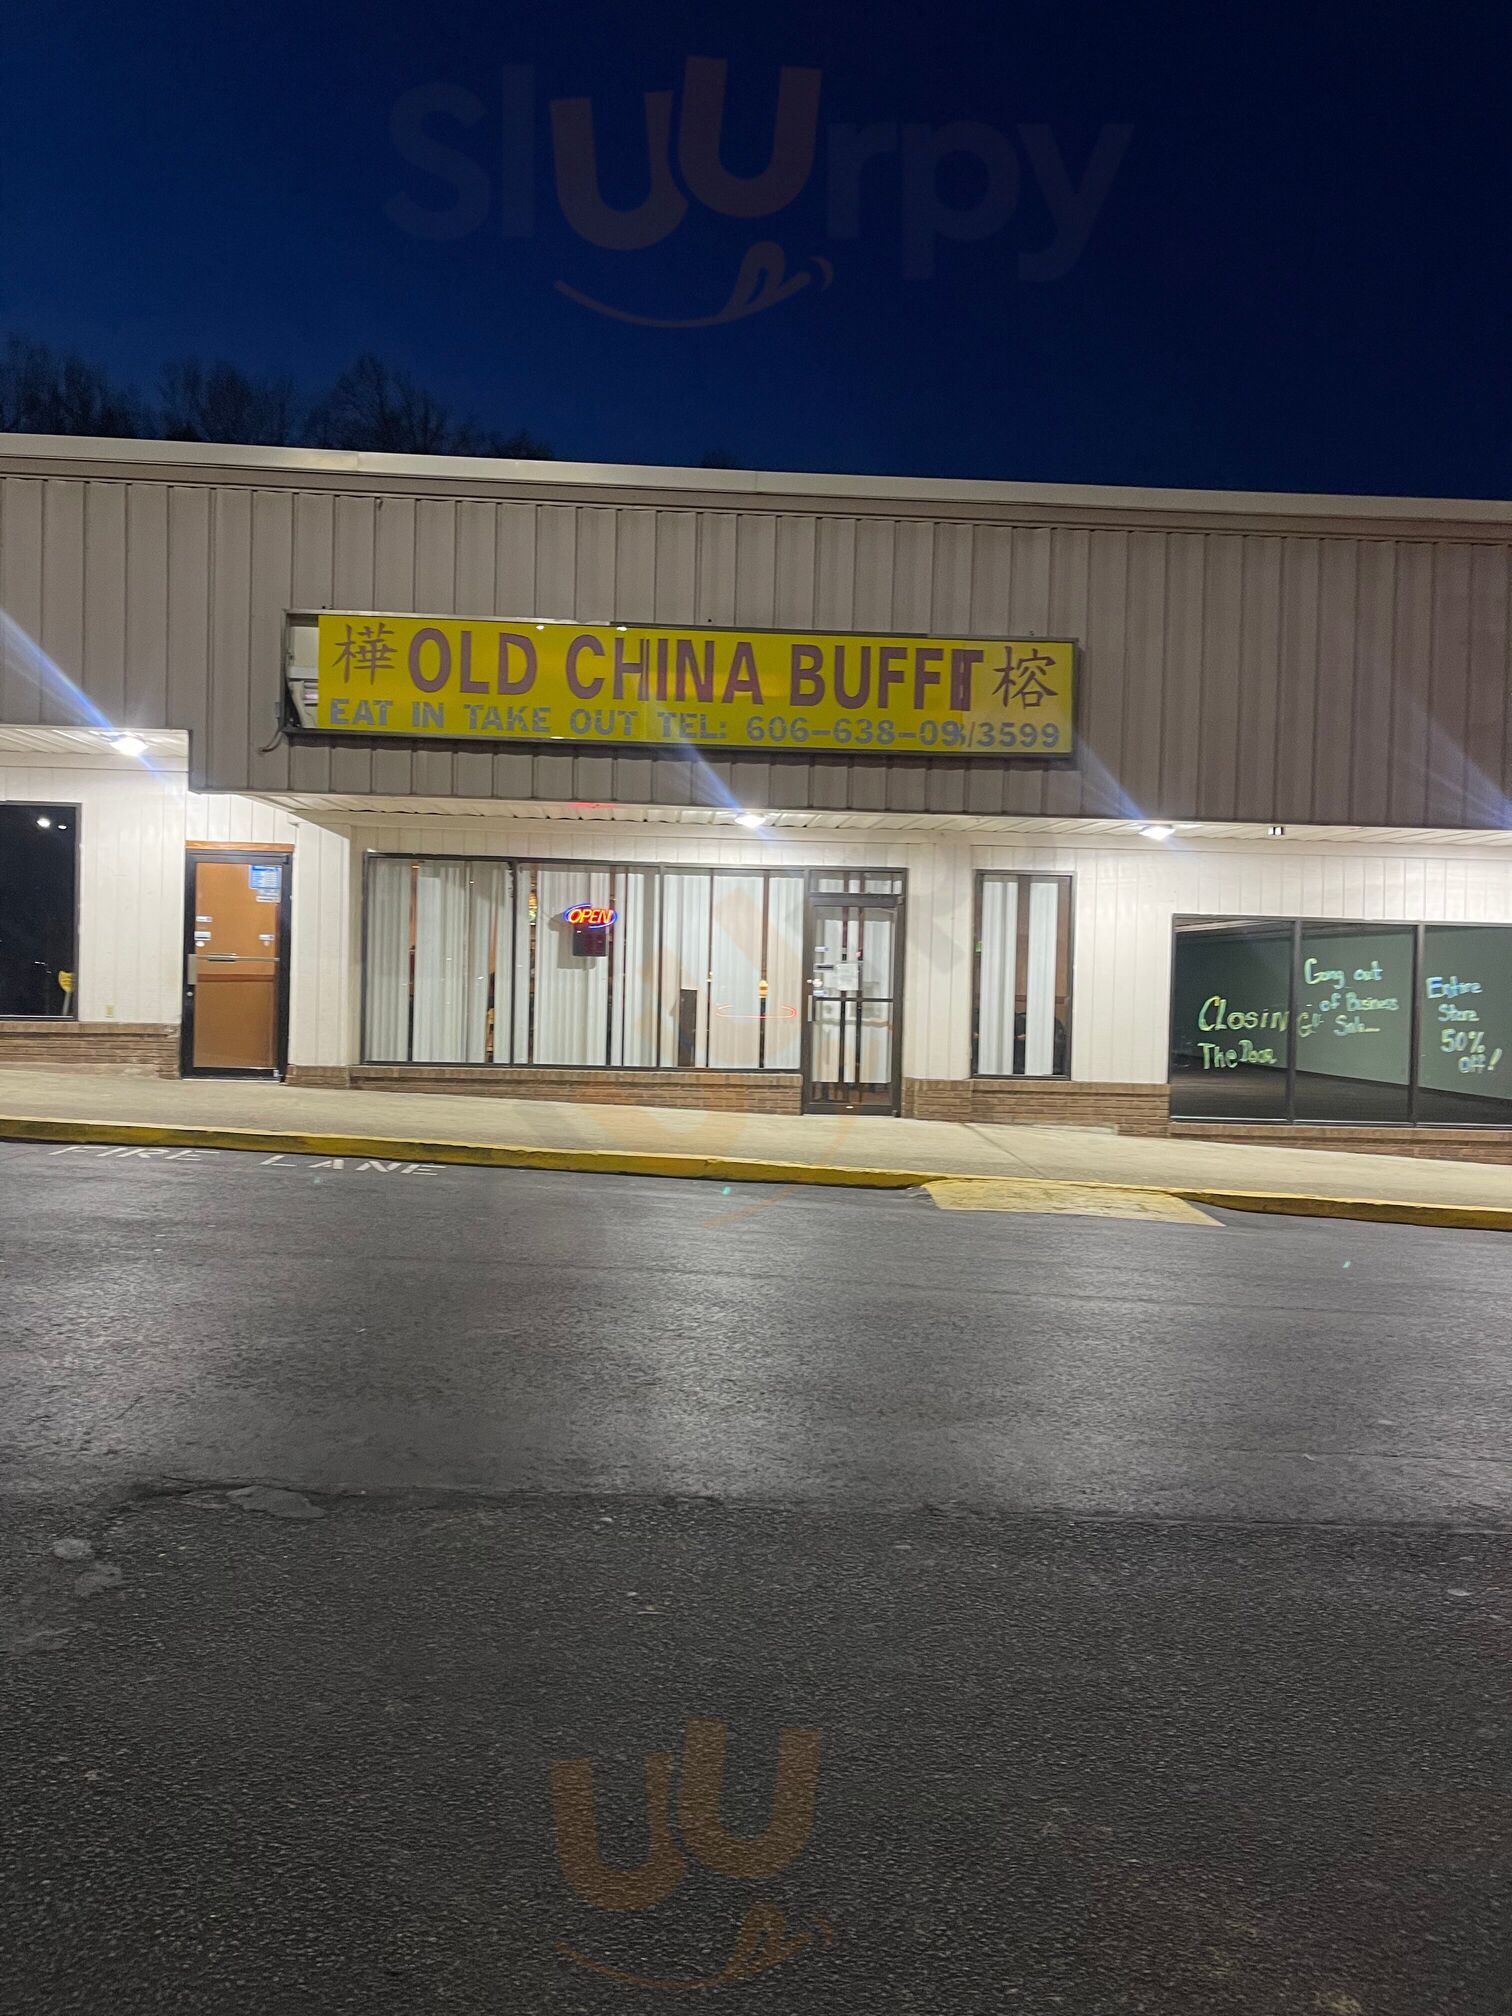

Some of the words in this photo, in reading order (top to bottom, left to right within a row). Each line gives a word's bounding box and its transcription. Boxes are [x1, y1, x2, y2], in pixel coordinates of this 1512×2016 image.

[408, 628, 538, 696] OLD
[565, 633, 765, 706] CHINA
[992, 645, 1059, 710] 榕
[329, 697, 394, 727] EAT
[411, 701, 445, 730] IN
[463, 703, 552, 734] TAKE
[569, 708, 639, 737] OUT
[657, 711, 728, 740] TEL:
[567, 906, 613, 925] OPEN
[1319, 992, 1341, 1012] of
[1440, 1028, 1486, 1053] 50%
[1197, 1042, 1238, 1070] The
[48, 1145, 220, 1162] FIRE
[258, 1155, 449, 1176] LANE
